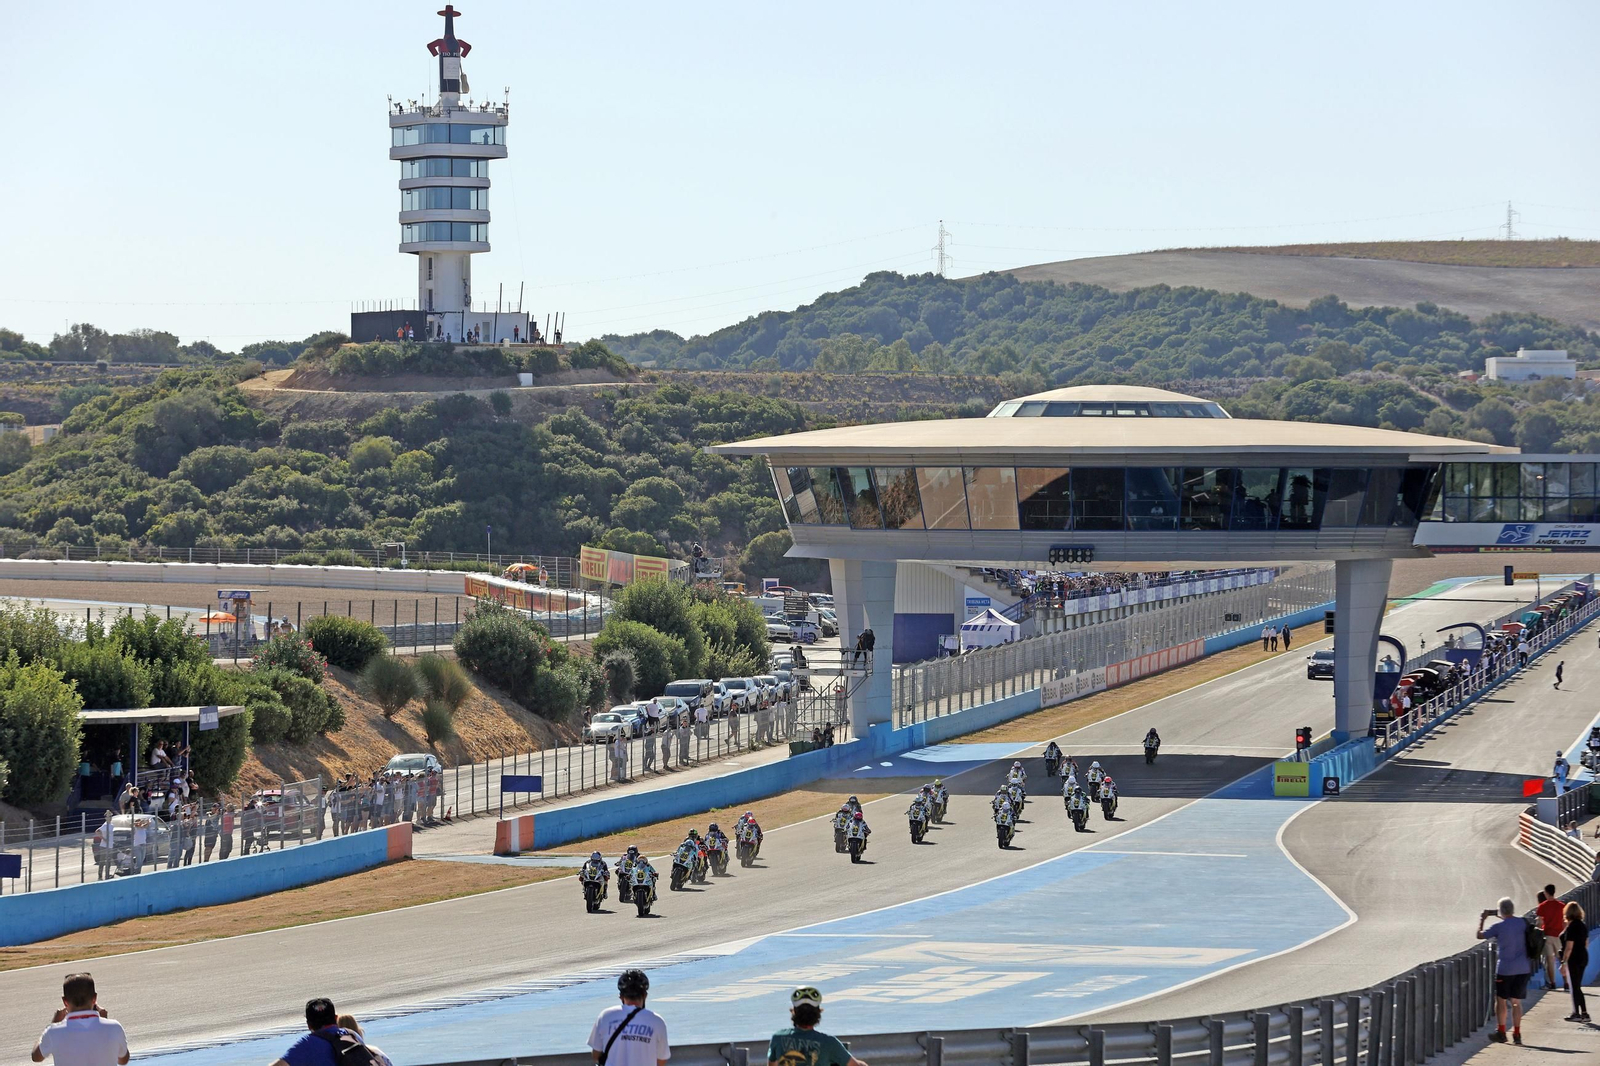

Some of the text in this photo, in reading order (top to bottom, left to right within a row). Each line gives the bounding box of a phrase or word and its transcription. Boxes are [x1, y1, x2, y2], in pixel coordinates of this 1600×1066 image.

[1539, 530, 1592, 538] JEREZ
[223, 602, 228, 611] 4
[608, 1019, 654, 1037] FCTION
[781, 1036, 821, 1056] VANS
